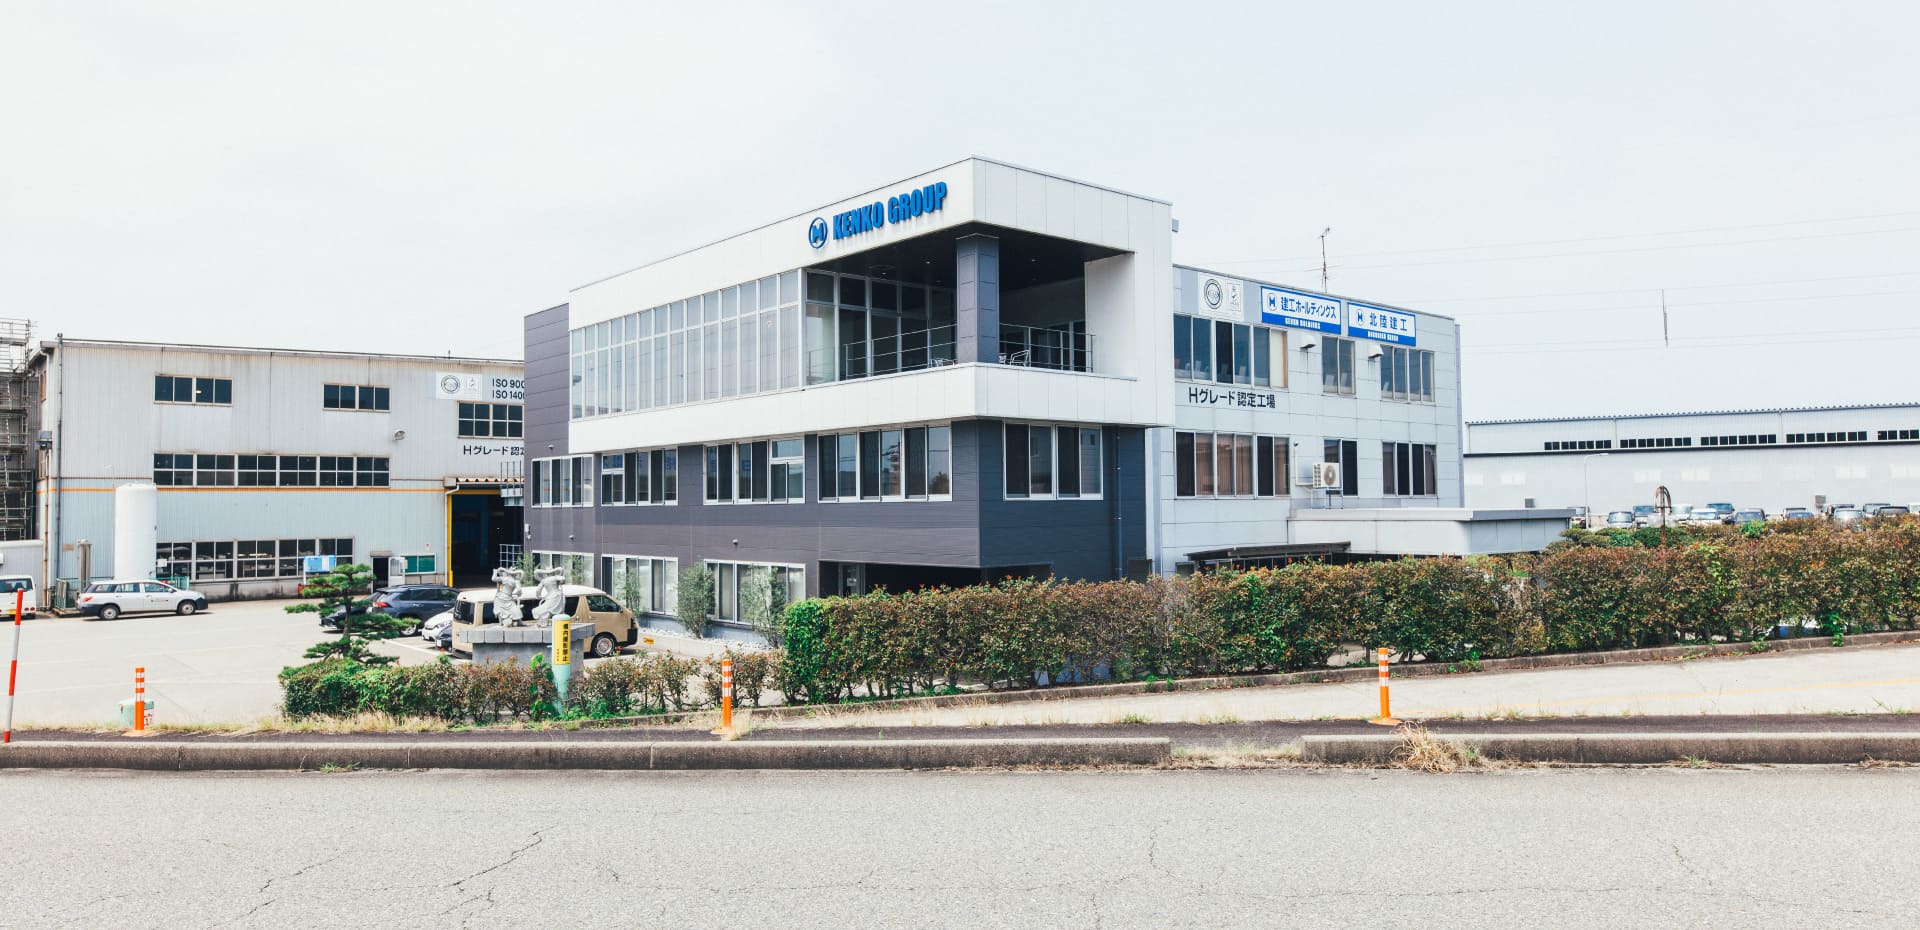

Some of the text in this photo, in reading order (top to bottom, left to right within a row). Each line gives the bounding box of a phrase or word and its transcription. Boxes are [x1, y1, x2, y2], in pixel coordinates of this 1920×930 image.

[833, 181, 948, 240] KENKO GROUP
[1369, 312, 1408, 331] 北陸建工
[492, 378, 507, 388] ISO
[492, 390, 524, 400] ISO 140
